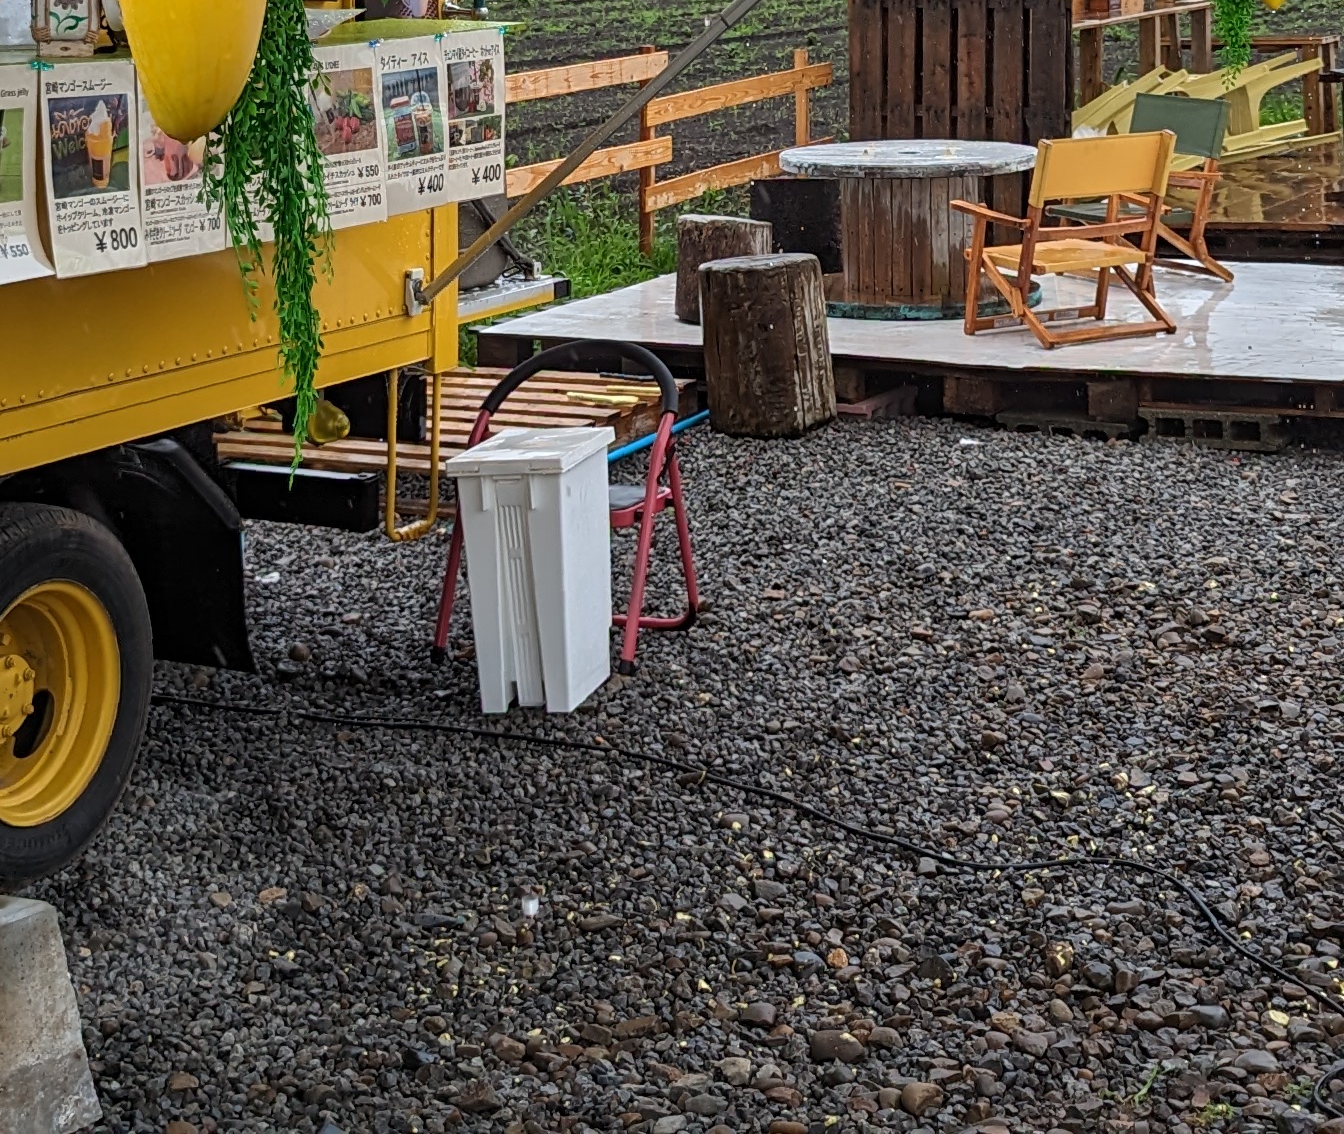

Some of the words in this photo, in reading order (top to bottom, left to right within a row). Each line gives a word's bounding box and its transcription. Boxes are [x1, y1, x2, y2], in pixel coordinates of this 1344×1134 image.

[381, 54, 408, 70] タイティー
[411, 51, 429, 66] アイス
[0, 89, 16, 99] Grass
[17, 87, 29, 100] jelly
[45, 77, 113, 95] 宮崎マンゴースムージー
[357, 163, 380, 179] ¥550
[472, 163, 502, 186] ¥400
[418, 173, 445, 195] ¥400
[360, 193, 382, 208] ¥700
[199, 217, 221, 233] ¥700
[94, 227, 138, 253] ¥800
[0, 243, 29, 259] ¥550
